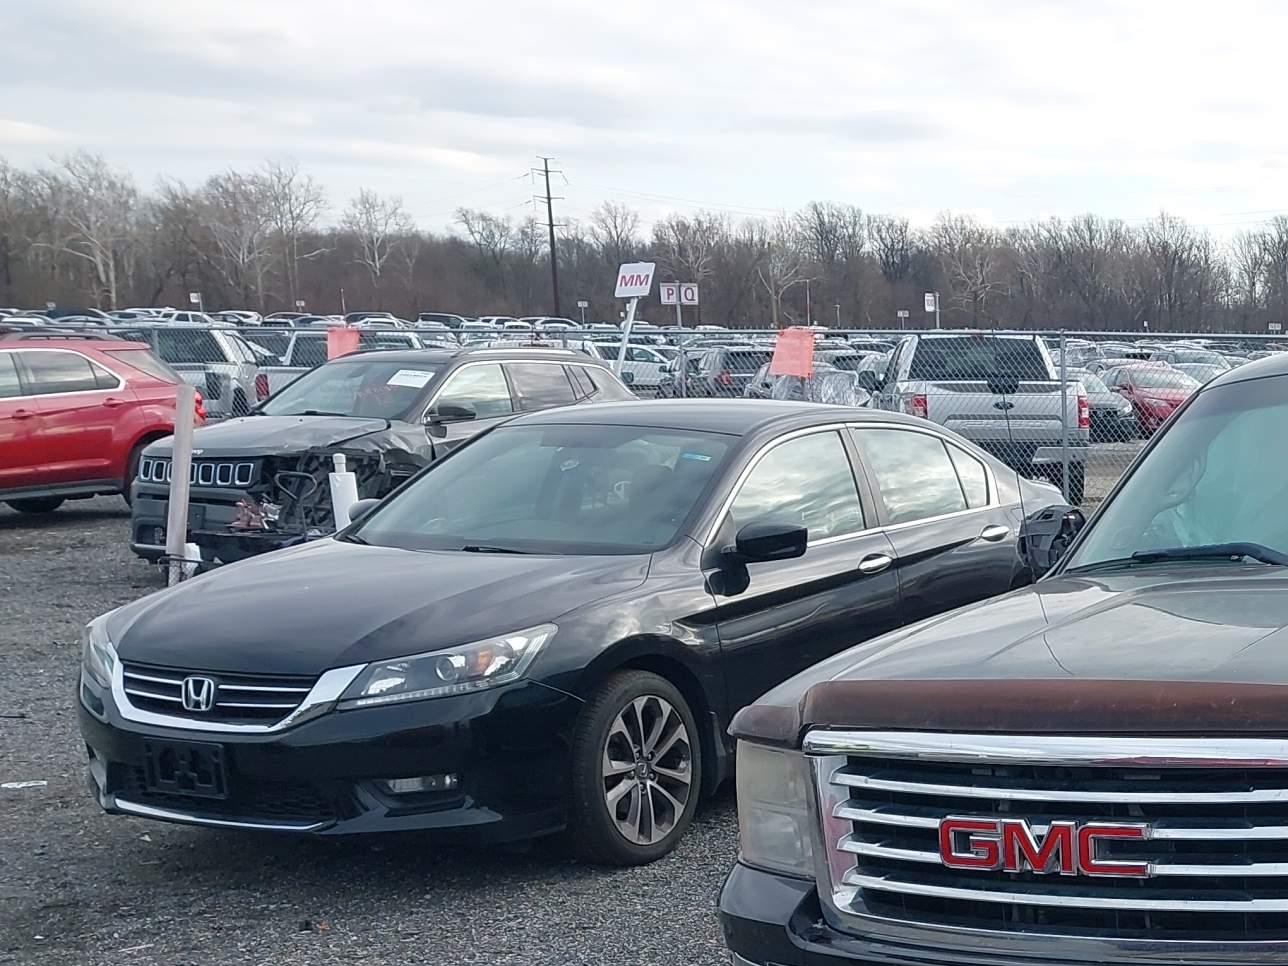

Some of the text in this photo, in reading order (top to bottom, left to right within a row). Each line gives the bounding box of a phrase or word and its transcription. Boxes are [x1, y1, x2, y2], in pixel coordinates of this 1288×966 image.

[619, 274, 650, 287] MM
[666, 288, 675, 301] P
[684, 287, 696, 302] Q
[938, 815, 1153, 880] GMC
